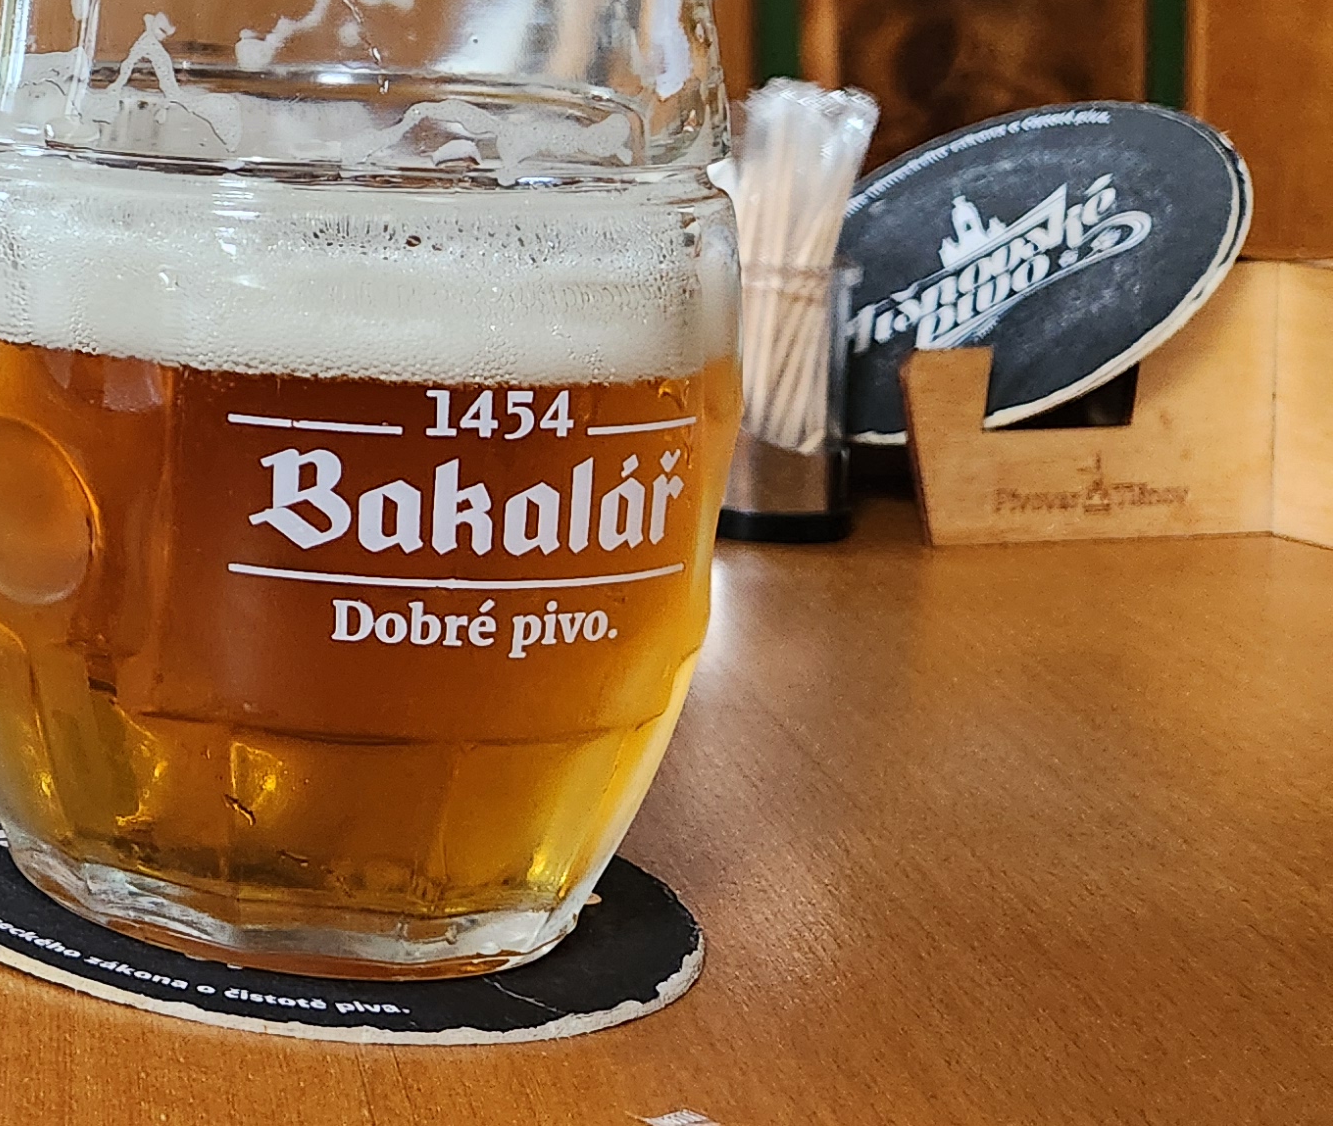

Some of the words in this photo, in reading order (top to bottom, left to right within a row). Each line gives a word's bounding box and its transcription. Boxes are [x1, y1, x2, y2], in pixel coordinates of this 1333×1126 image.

[915, 253, 1050, 349] pivo
[425, 389, 575, 440] 1454
[248, 447, 684, 557] Bakalář
[331, 599, 495, 648] Dobré
[508, 601, 618, 660] pivo.
[83, 955, 189, 990] zákona
[195, 983, 217, 995] o
[224, 986, 327, 1012] čistotě
[333, 999, 411, 1015] piva.
